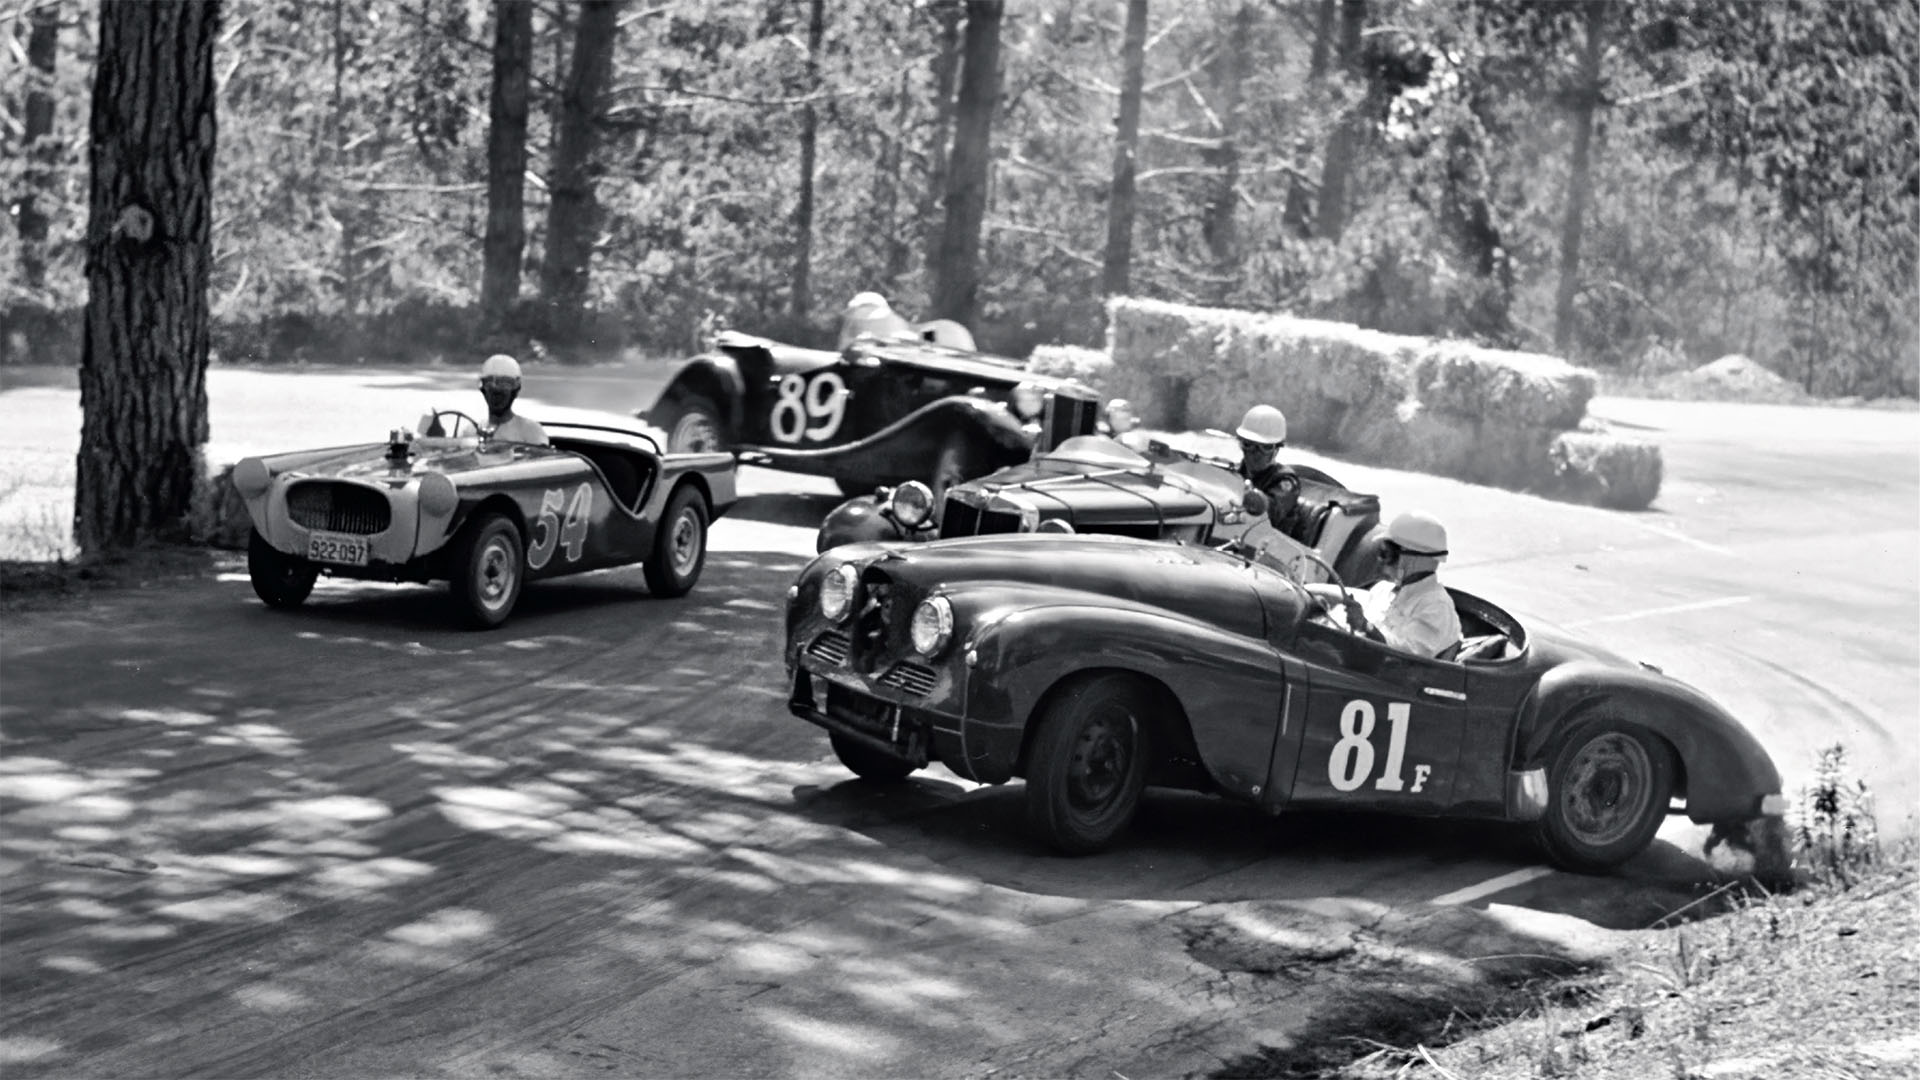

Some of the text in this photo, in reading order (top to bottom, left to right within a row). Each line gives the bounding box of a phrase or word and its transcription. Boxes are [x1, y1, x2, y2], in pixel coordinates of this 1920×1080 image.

[770, 372, 848, 442] 89
[527, 482, 592, 569] 54
[1328, 699, 1431, 793] 81 F
